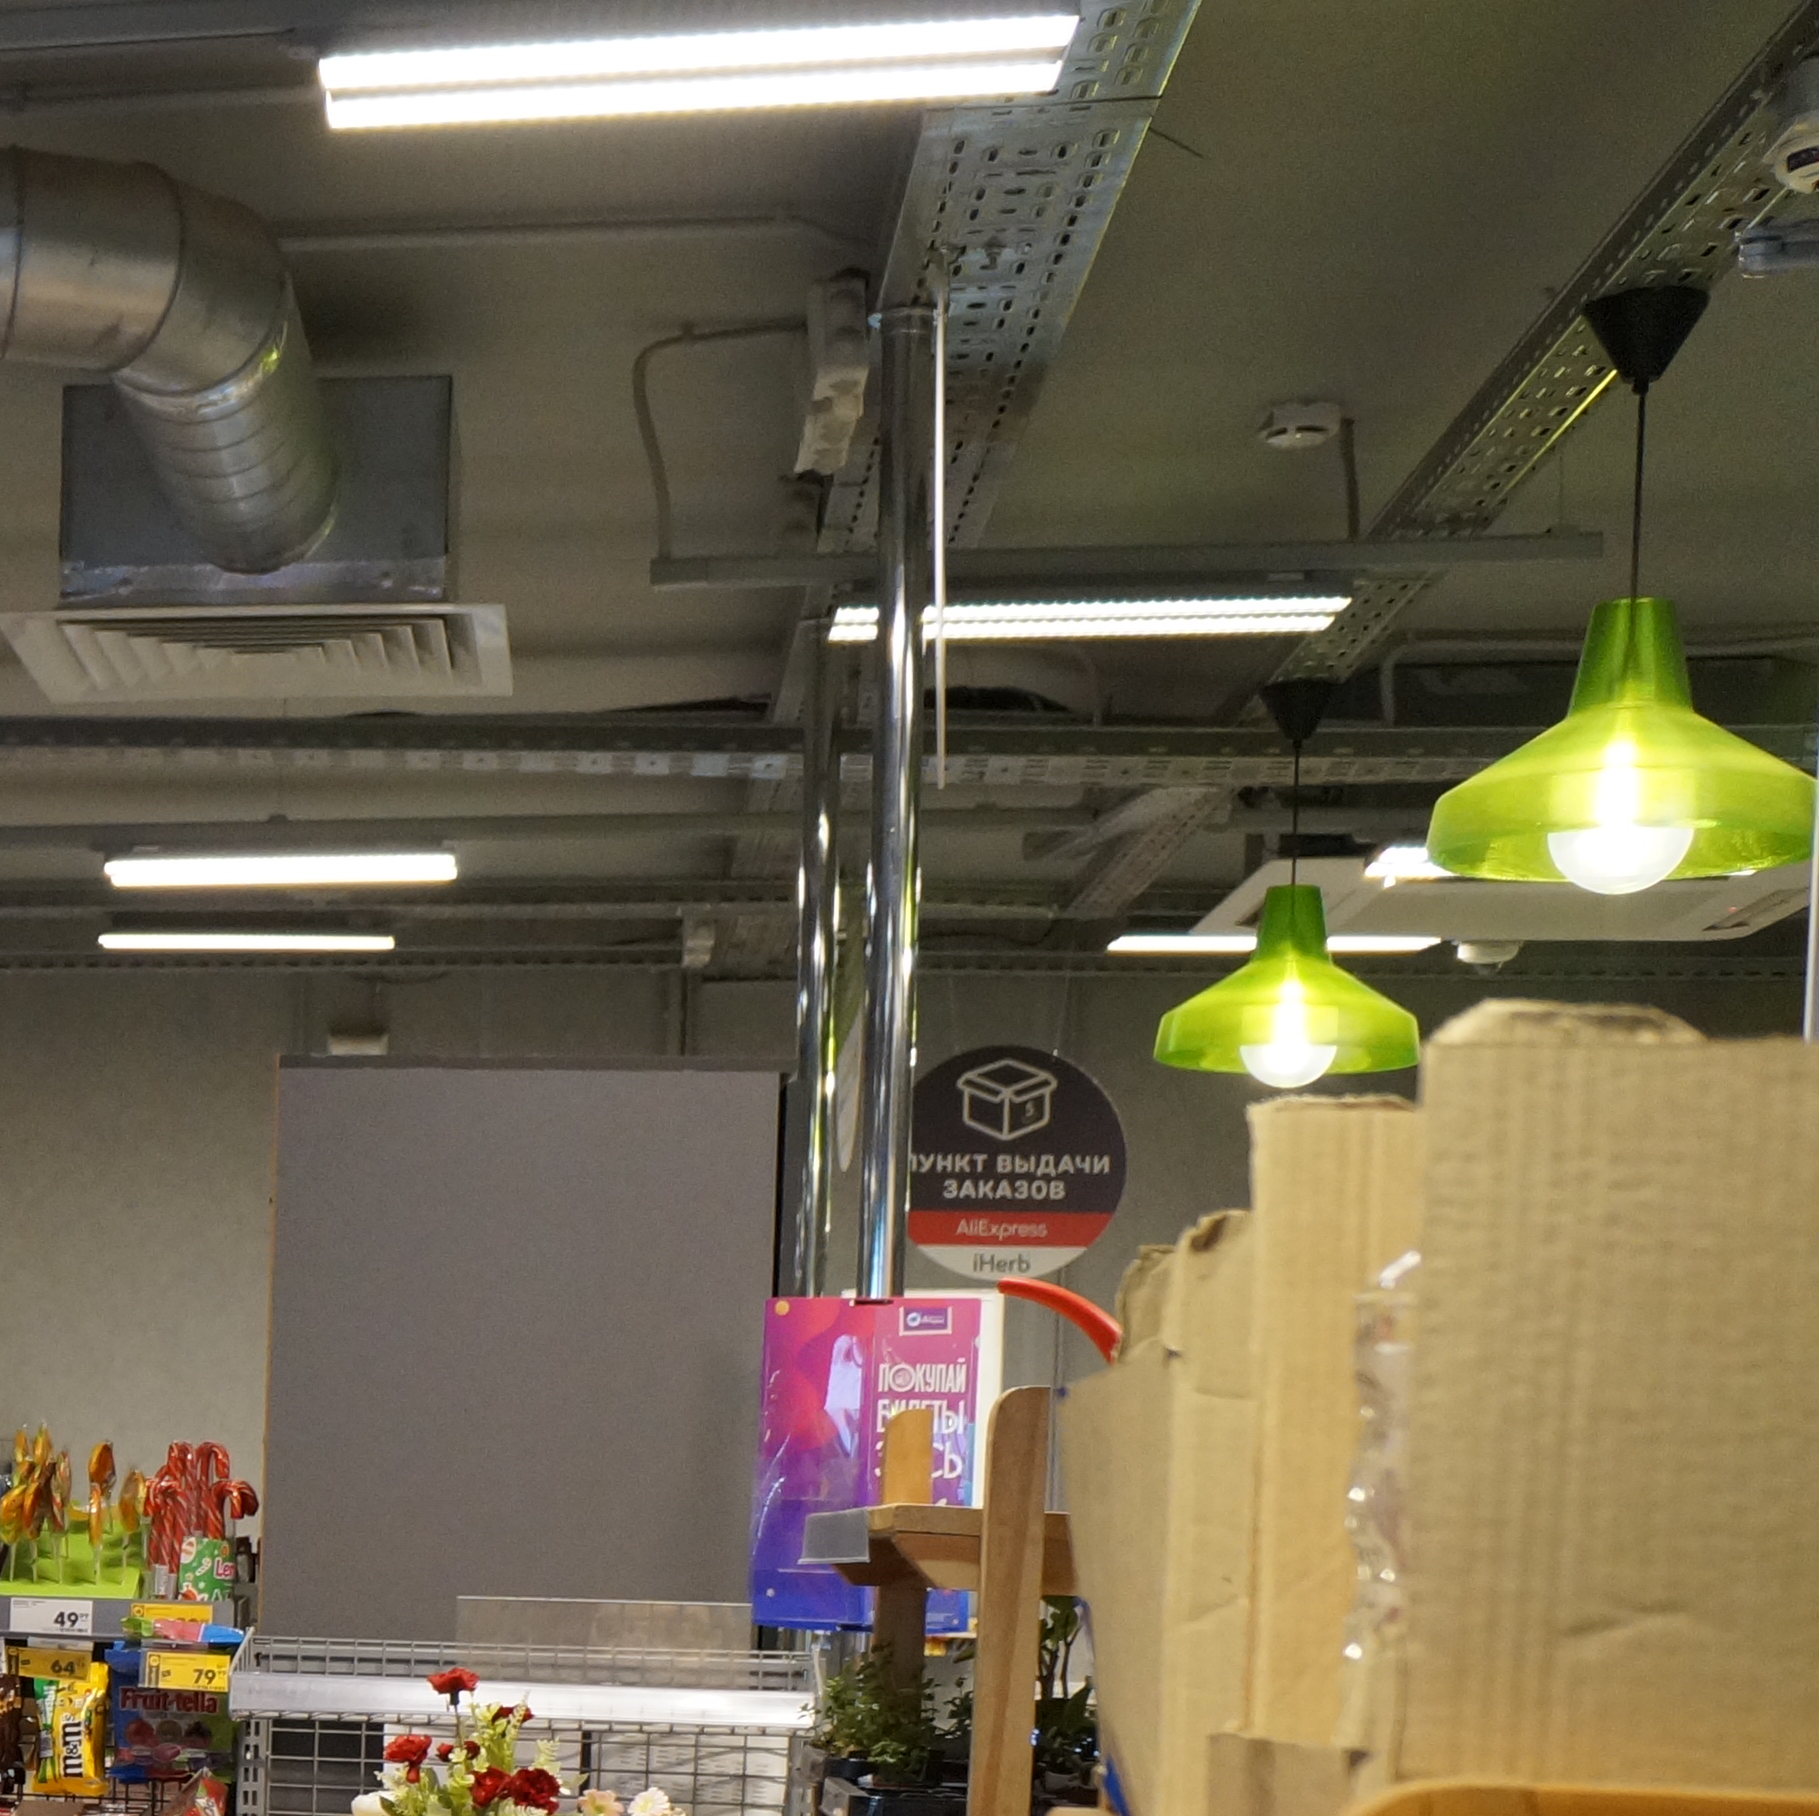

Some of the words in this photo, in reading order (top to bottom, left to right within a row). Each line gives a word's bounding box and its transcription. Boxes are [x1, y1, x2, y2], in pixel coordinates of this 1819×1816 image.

[997, 1152, 1110, 1176] ВЫДАЧИ
[942, 1179, 1066, 1199] ЗАКАЗОВ
[956, 1217, 1048, 1240] AliExpress
[973, 1252, 1030, 1273] iHerb
[878, 1358, 967, 1394] ПОКУПАЙ
[53, 1611, 79, 1628] 49
[50, 1659, 75, 1676] 64
[191, 1669, 217, 1685] 79
